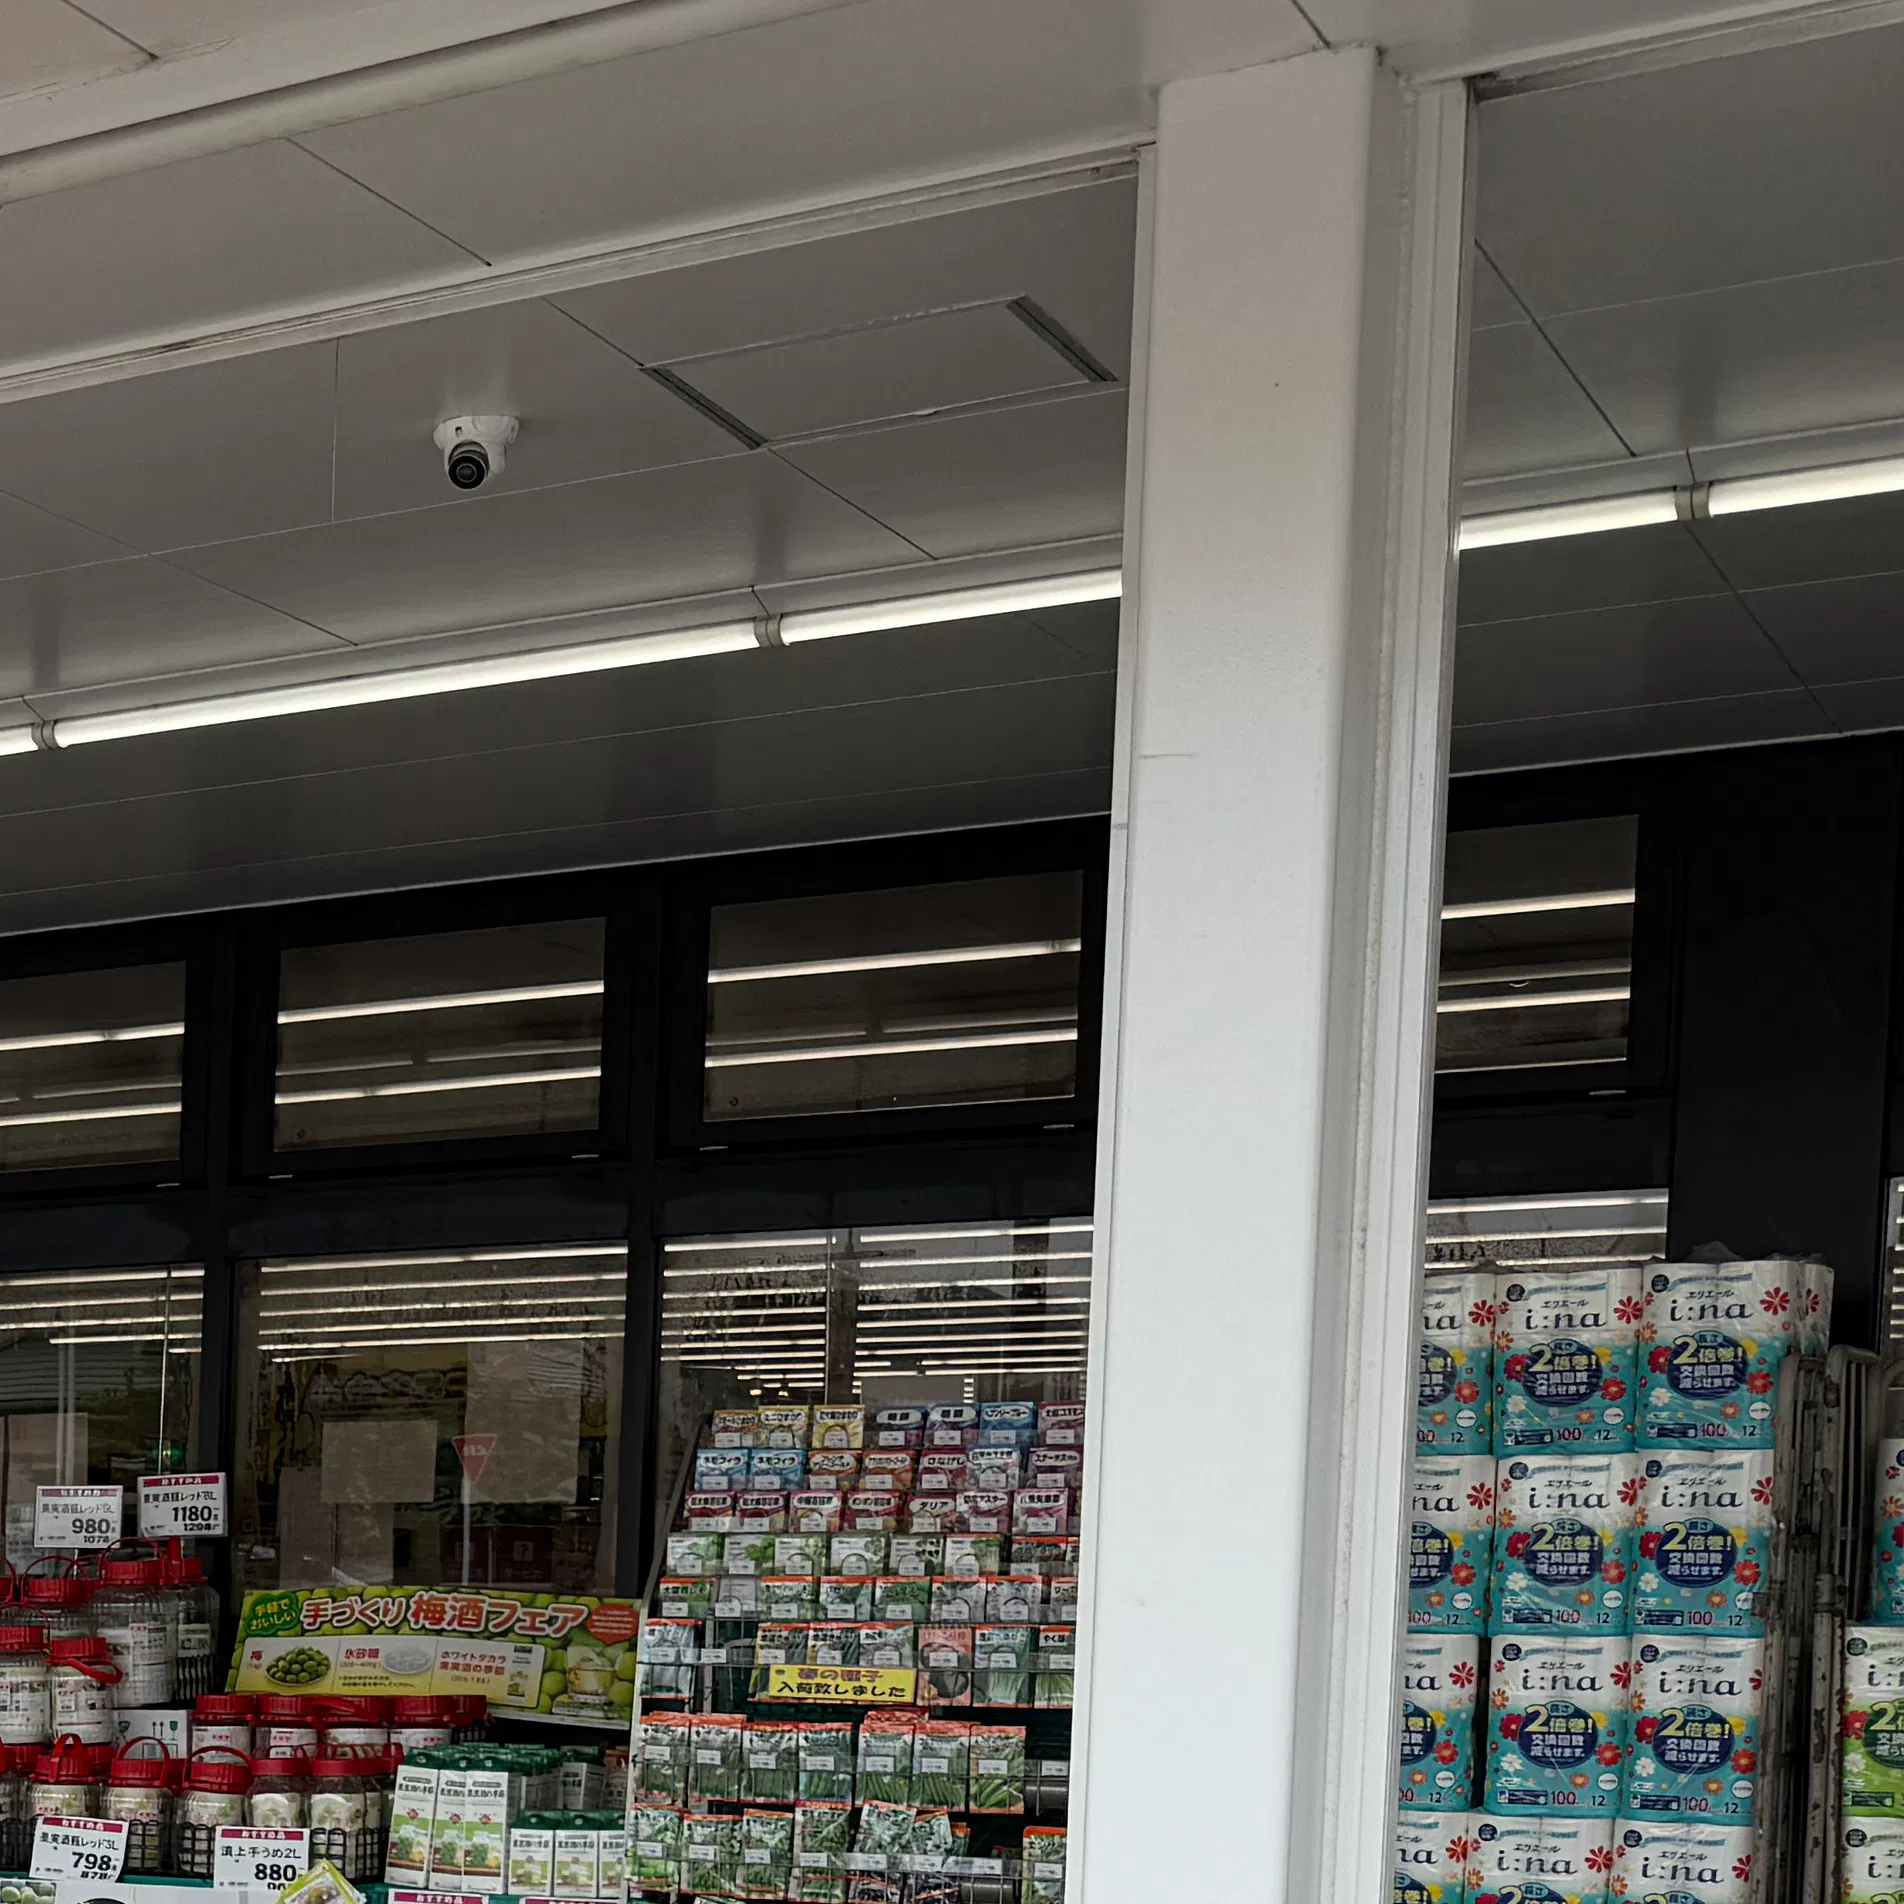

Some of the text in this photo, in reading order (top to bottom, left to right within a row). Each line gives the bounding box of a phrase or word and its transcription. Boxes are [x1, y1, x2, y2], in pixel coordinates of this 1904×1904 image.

[1670, 1299, 1753, 1322] i:na
[1525, 1309, 1606, 1330] i:na
[1451, 1432, 1465, 1443] 12
[1557, 1428, 1582, 1440] 100
[1597, 1430, 1611, 1440] 12
[1743, 1426, 1757, 1437] 12
[1529, 1487, 1610, 1508] i:na
[1661, 1486, 1743, 1508] i:na
[173, 1506, 213, 1522] 1180
[72, 1518, 111, 1534] 980
[255, 1598, 290, 1616] 手軽で
[300, 1591, 589, 1638] 手づくり梅酒フェア
[250, 1611, 296, 1631] おいしい
[1445, 1613, 1460, 1625] 12
[1555, 1610, 1580, 1623] 100
[1596, 1612, 1610, 1623] 12
[1688, 1611, 1712, 1625] 100
[1728, 1614, 1743, 1626] 12
[1522, 1668, 1603, 1691] i:na
[1659, 1671, 1742, 1696] i:na
[776, 1681, 906, 1698] 入荷致しました
[1551, 1791, 1577, 1805] 100
[1592, 1795, 1606, 1806] 12
[1683, 1797, 1709, 1811] 100
[1724, 1802, 1739, 1814] 12
[72, 1851, 113, 1871] 798
[1497, 1850, 1578, 1875] i:na
[254, 1862, 297, 1882] 880
[1641, 1857, 1724, 1884] i:na
